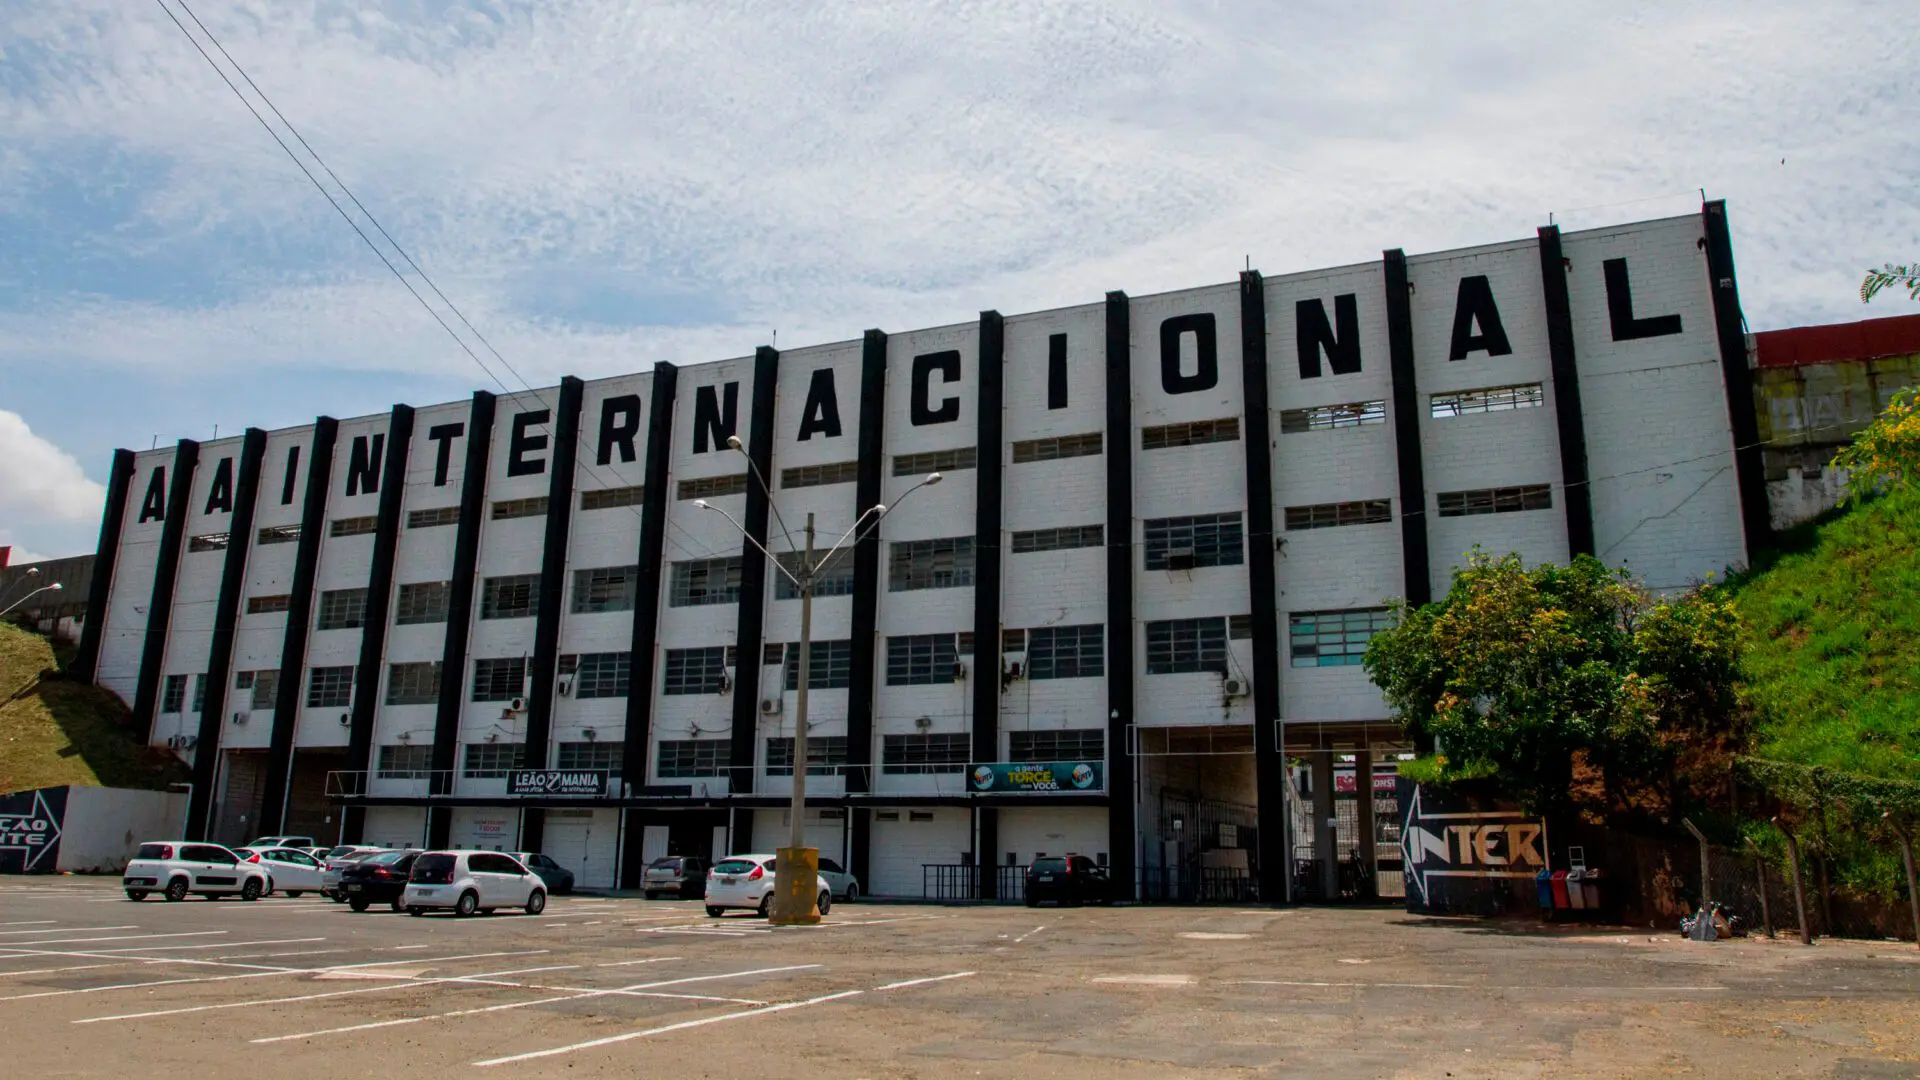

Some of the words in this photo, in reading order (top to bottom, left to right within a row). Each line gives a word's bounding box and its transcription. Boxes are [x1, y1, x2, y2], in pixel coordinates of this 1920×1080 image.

[516, 771, 546, 786] LEÃO
[561, 773, 599, 786] MANIA
[1007, 771, 1052, 784] TORCE
[1408, 824, 1545, 865] INTER
